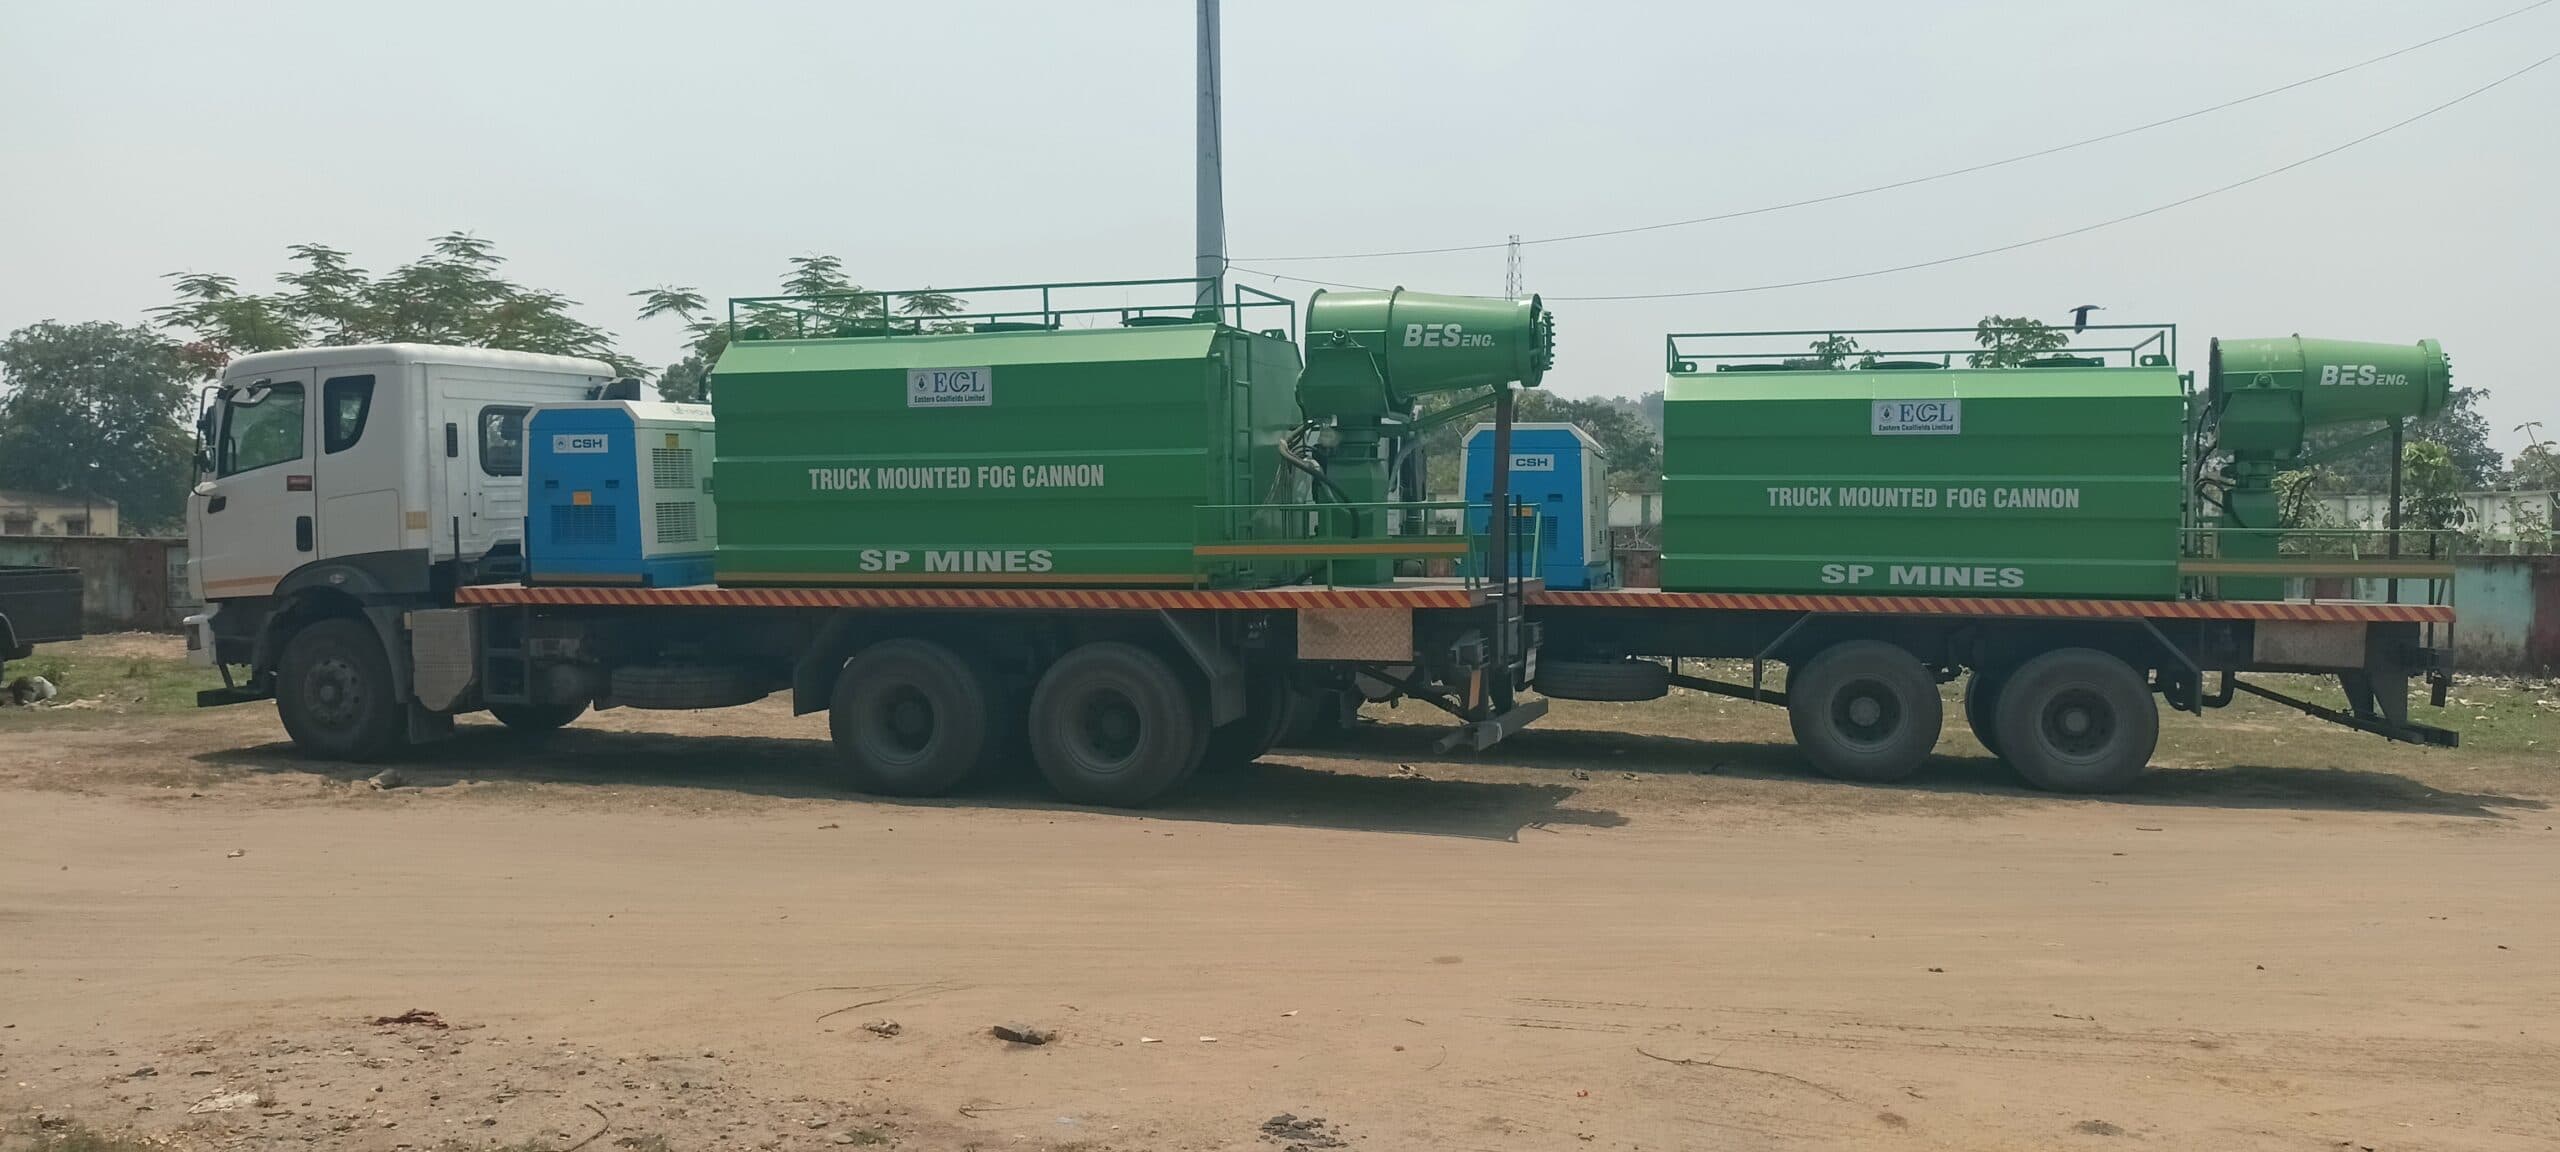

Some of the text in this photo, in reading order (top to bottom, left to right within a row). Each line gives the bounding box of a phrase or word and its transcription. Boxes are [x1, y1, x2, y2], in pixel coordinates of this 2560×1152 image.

[1403, 323, 1462, 347] BES
[2320, 364, 2377, 386] BES
[914, 395, 935, 403] Eastern
[572, 439, 602, 449] CSH
[1515, 458, 1548, 467] CSH
[808, 464, 1105, 490] TRUCK MOUNTED FOG CANNON
[1767, 487, 2080, 509] TRUCK MOUNTED FOG CANNON
[859, 549, 1053, 573] SP MINES
[1821, 564, 2025, 588] SP MINES
